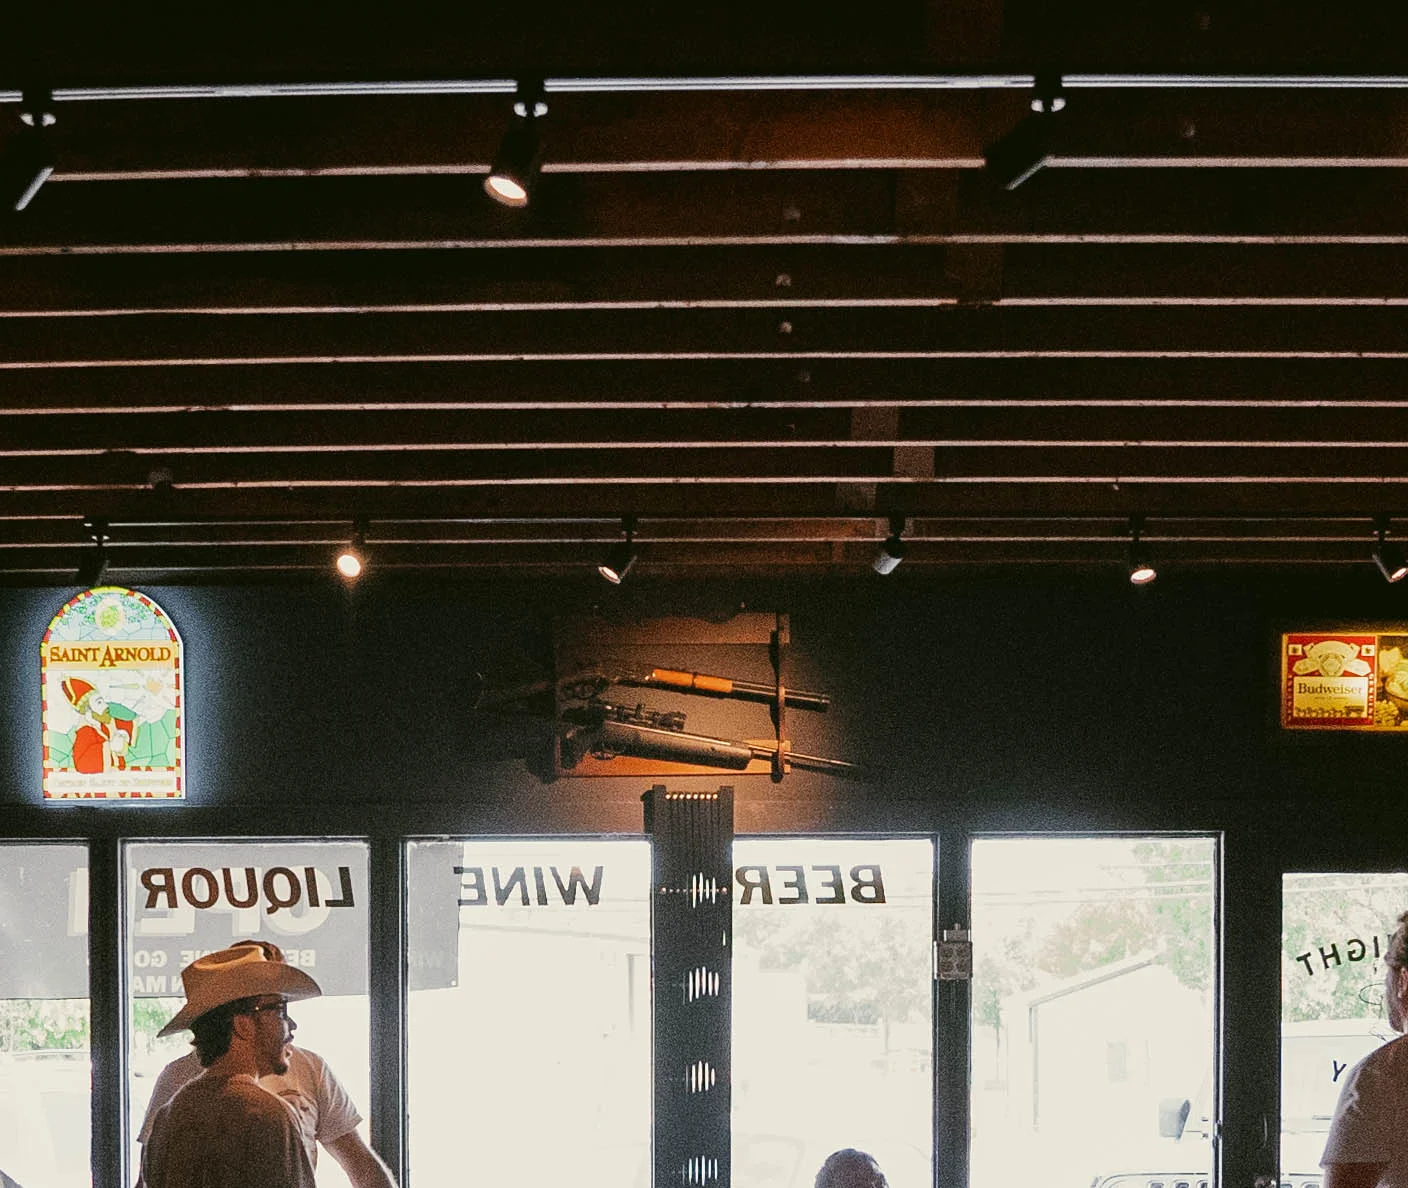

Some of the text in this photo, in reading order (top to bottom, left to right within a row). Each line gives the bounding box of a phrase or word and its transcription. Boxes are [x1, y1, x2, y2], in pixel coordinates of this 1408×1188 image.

[50, 645, 171, 667] SAINT ARNOLD
[1297, 682, 1363, 695] Budweiser
